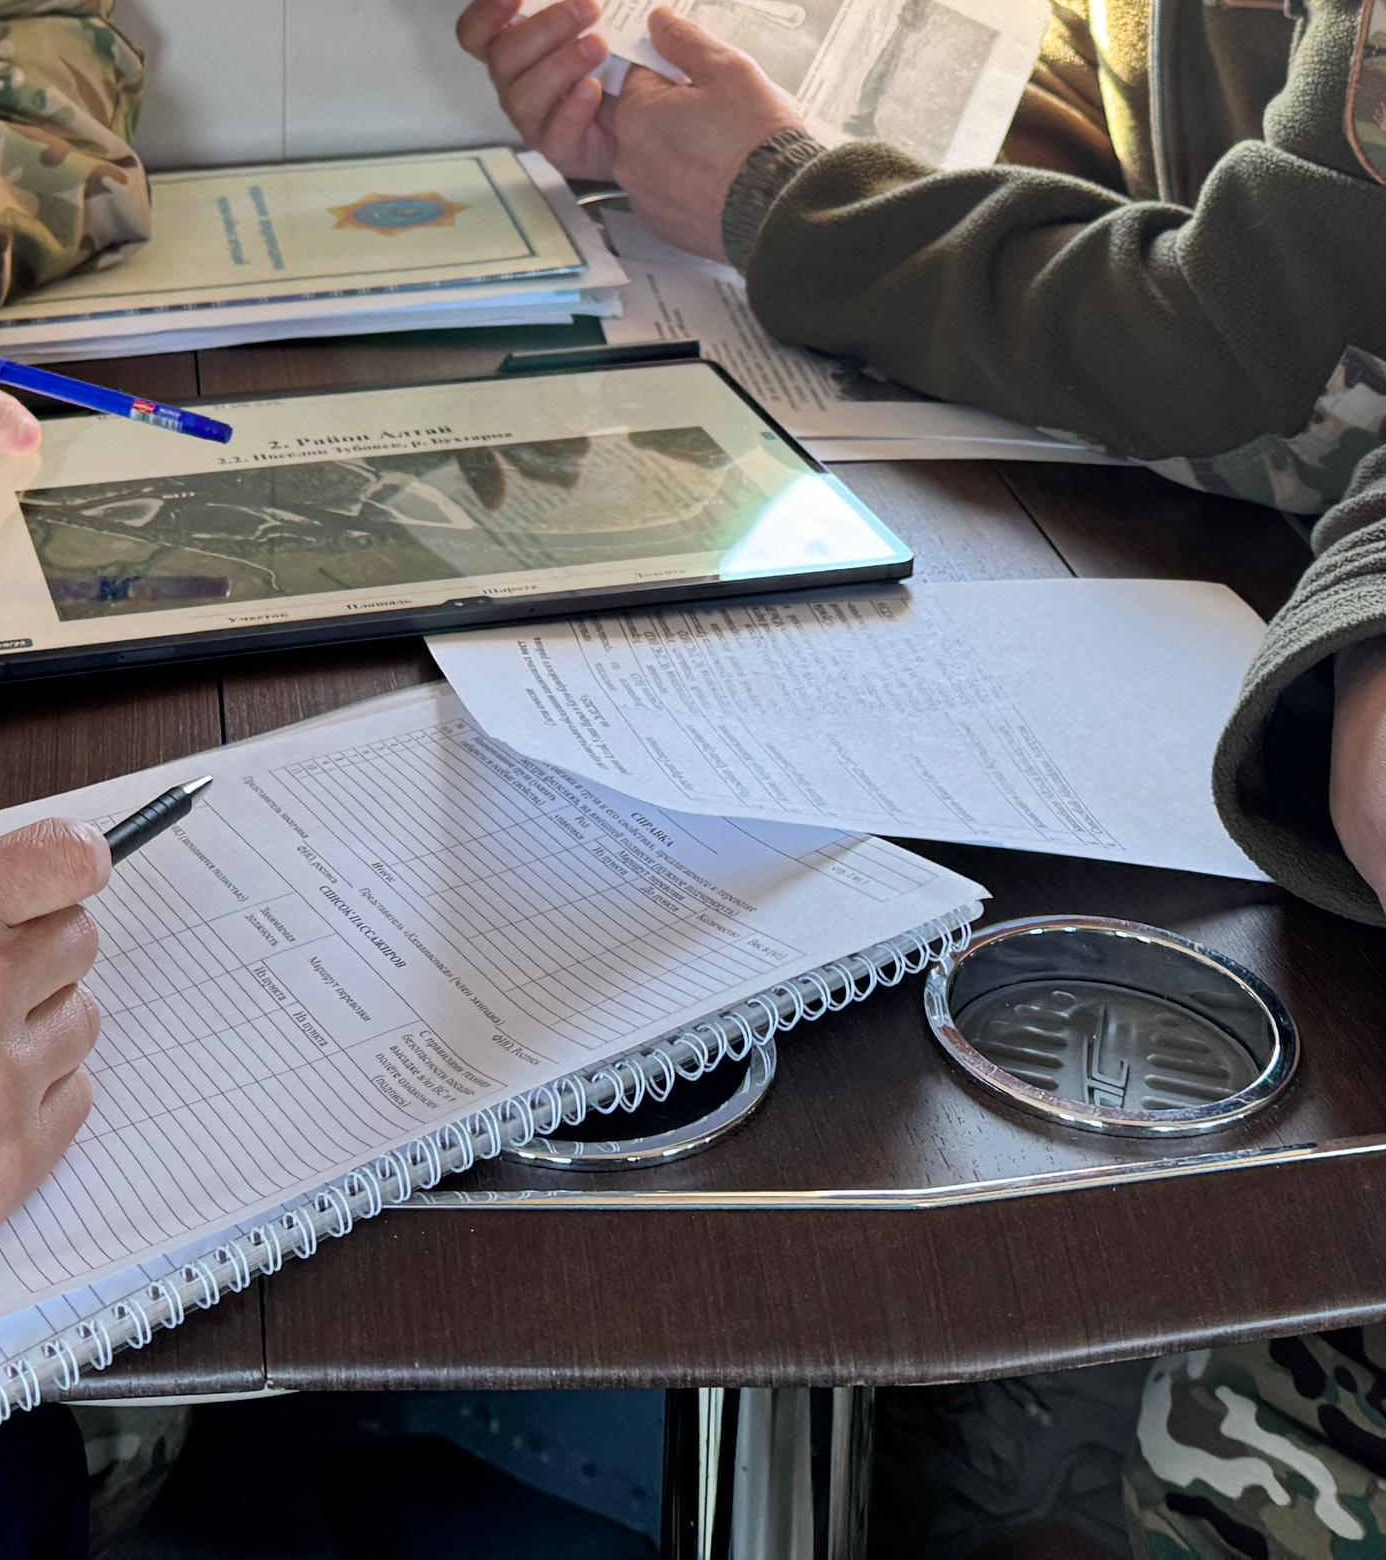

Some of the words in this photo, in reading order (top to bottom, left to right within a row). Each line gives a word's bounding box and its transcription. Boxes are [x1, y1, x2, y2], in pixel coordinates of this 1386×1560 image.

[268, 440, 289, 450] 2.
[296, 432, 372, 447] Район
[379, 424, 455, 439] Алтай
[216, 457, 248, 466] 2.2.
[627, 811, 679, 848] СПРАВКА
[314, 884, 356, 917] СПИСОК
[343, 913, 411, 970] ПАССАЖИРОВ
[250, 965, 271, 979] Из
[255, 975, 290, 1004] пункта
[301, 955, 345, 990] Маршрут
[330, 985, 375, 1024] перевозки
[290, 1009, 312, 1024] Из
[296, 1020, 332, 1049] пункта
[366, 1071, 414, 1112] (подпись)
